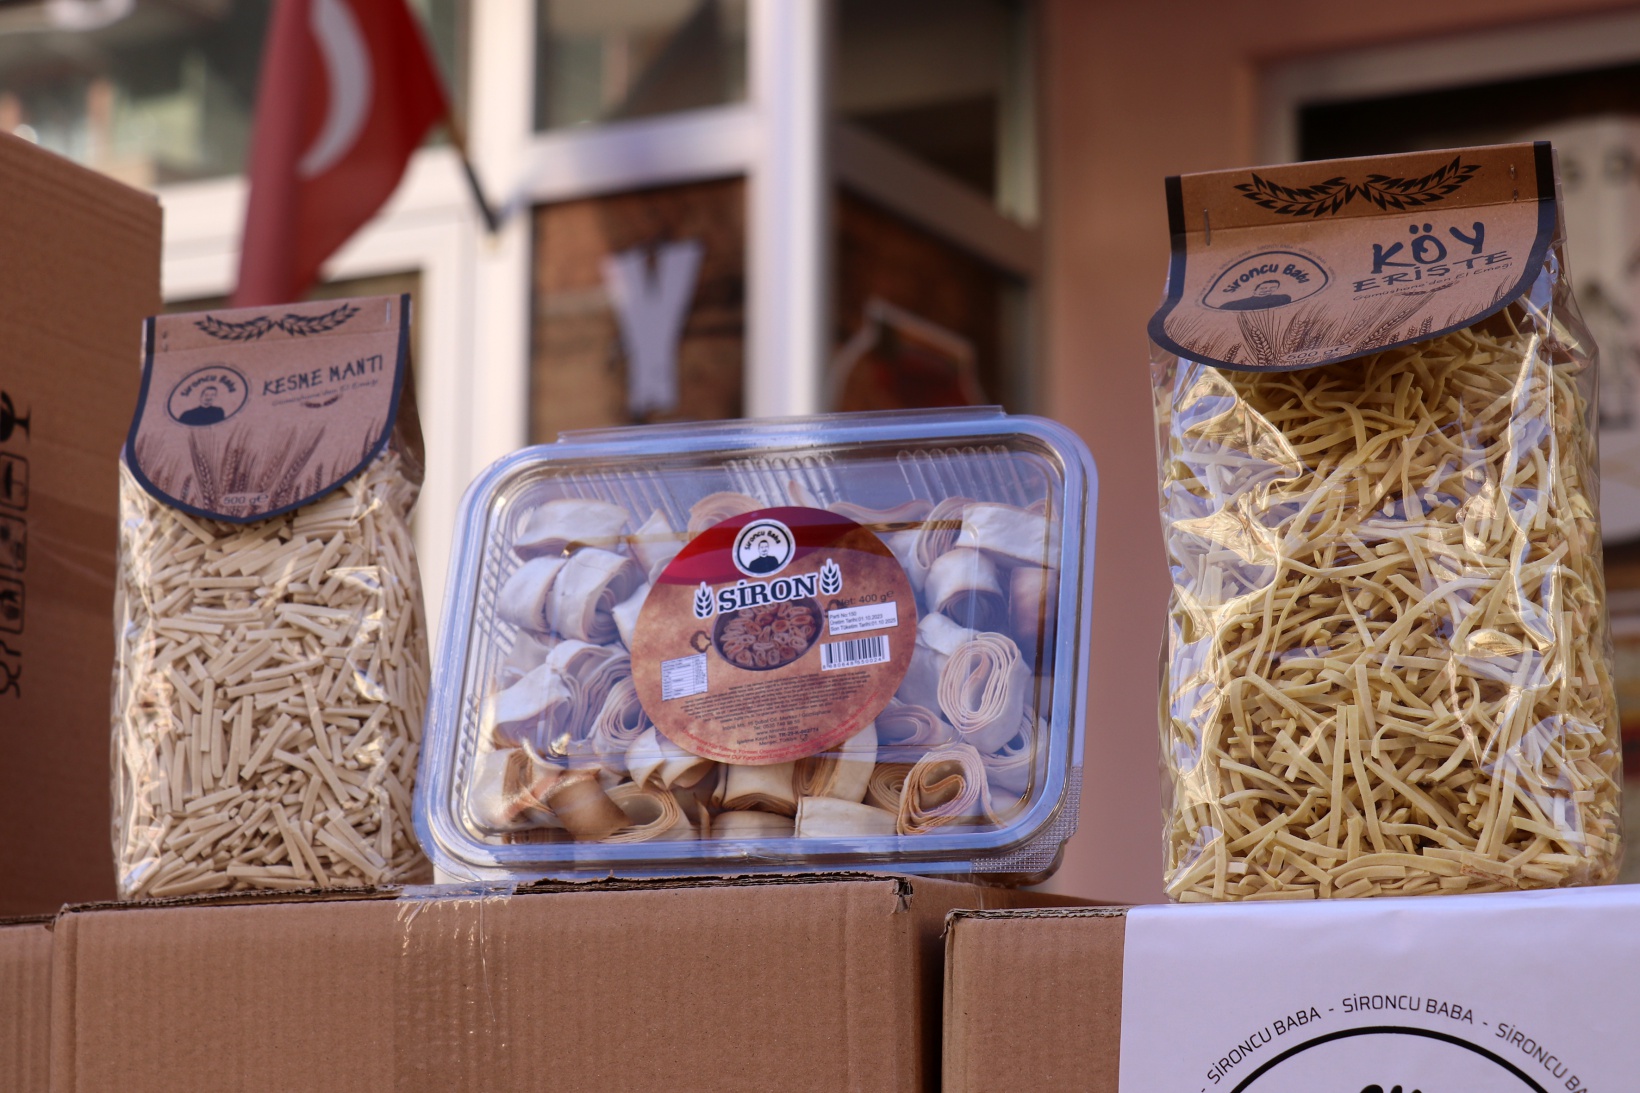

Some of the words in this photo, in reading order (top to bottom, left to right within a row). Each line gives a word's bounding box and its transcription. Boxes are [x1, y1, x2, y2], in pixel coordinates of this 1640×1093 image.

[1370, 221, 1485, 274] KÖY
[262, 368, 323, 396] KESME
[329, 354, 383, 382] MANTI
[718, 574, 816, 613] SİRON
[859, 594, 878, 604] 400
[1207, 1027, 1272, 1084] SİRONCU
[1273, 1006, 1321, 1036] BABA
[1342, 993, 1421, 1013] SİRONCU
[1425, 998, 1473, 1025] BABA
[1495, 1022, 1569, 1079] SİRONCU
